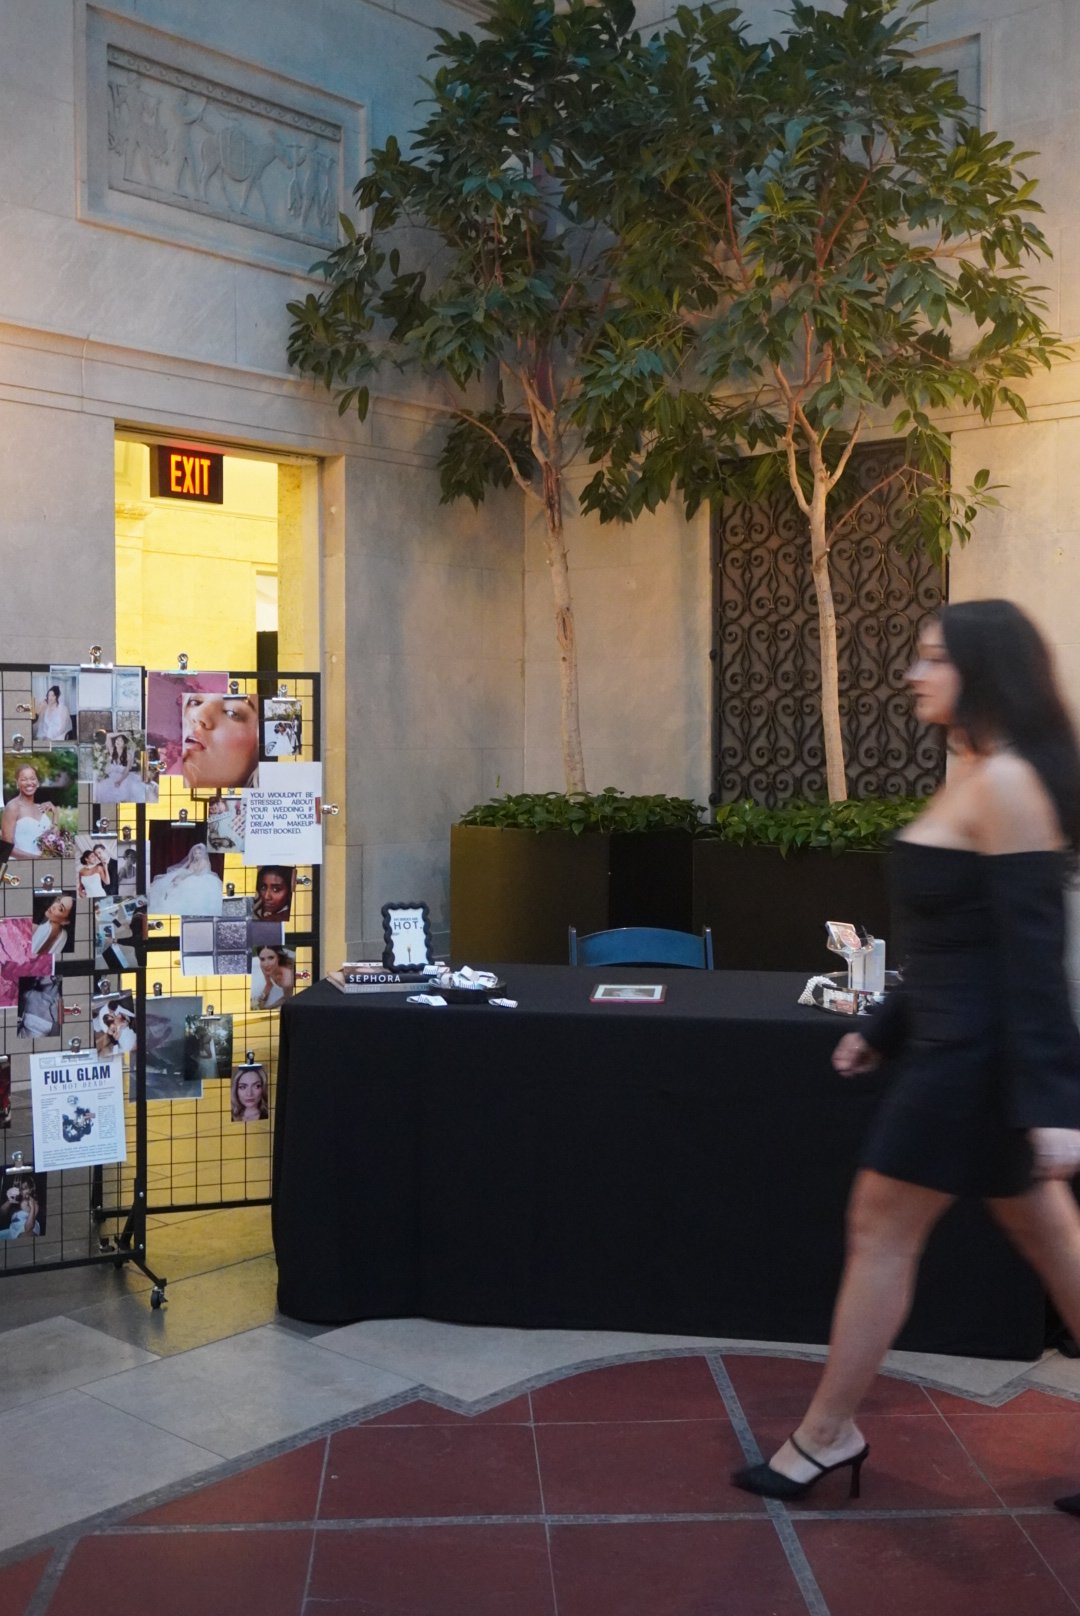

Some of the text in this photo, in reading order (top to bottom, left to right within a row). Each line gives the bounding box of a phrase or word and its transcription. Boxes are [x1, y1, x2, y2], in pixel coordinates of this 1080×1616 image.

[170, 454, 211, 496] EXIT
[393, 921, 423, 930] HOT.
[349, 974, 401, 983] SEPHORA
[44, 1065, 111, 1085] FULL GLAM
